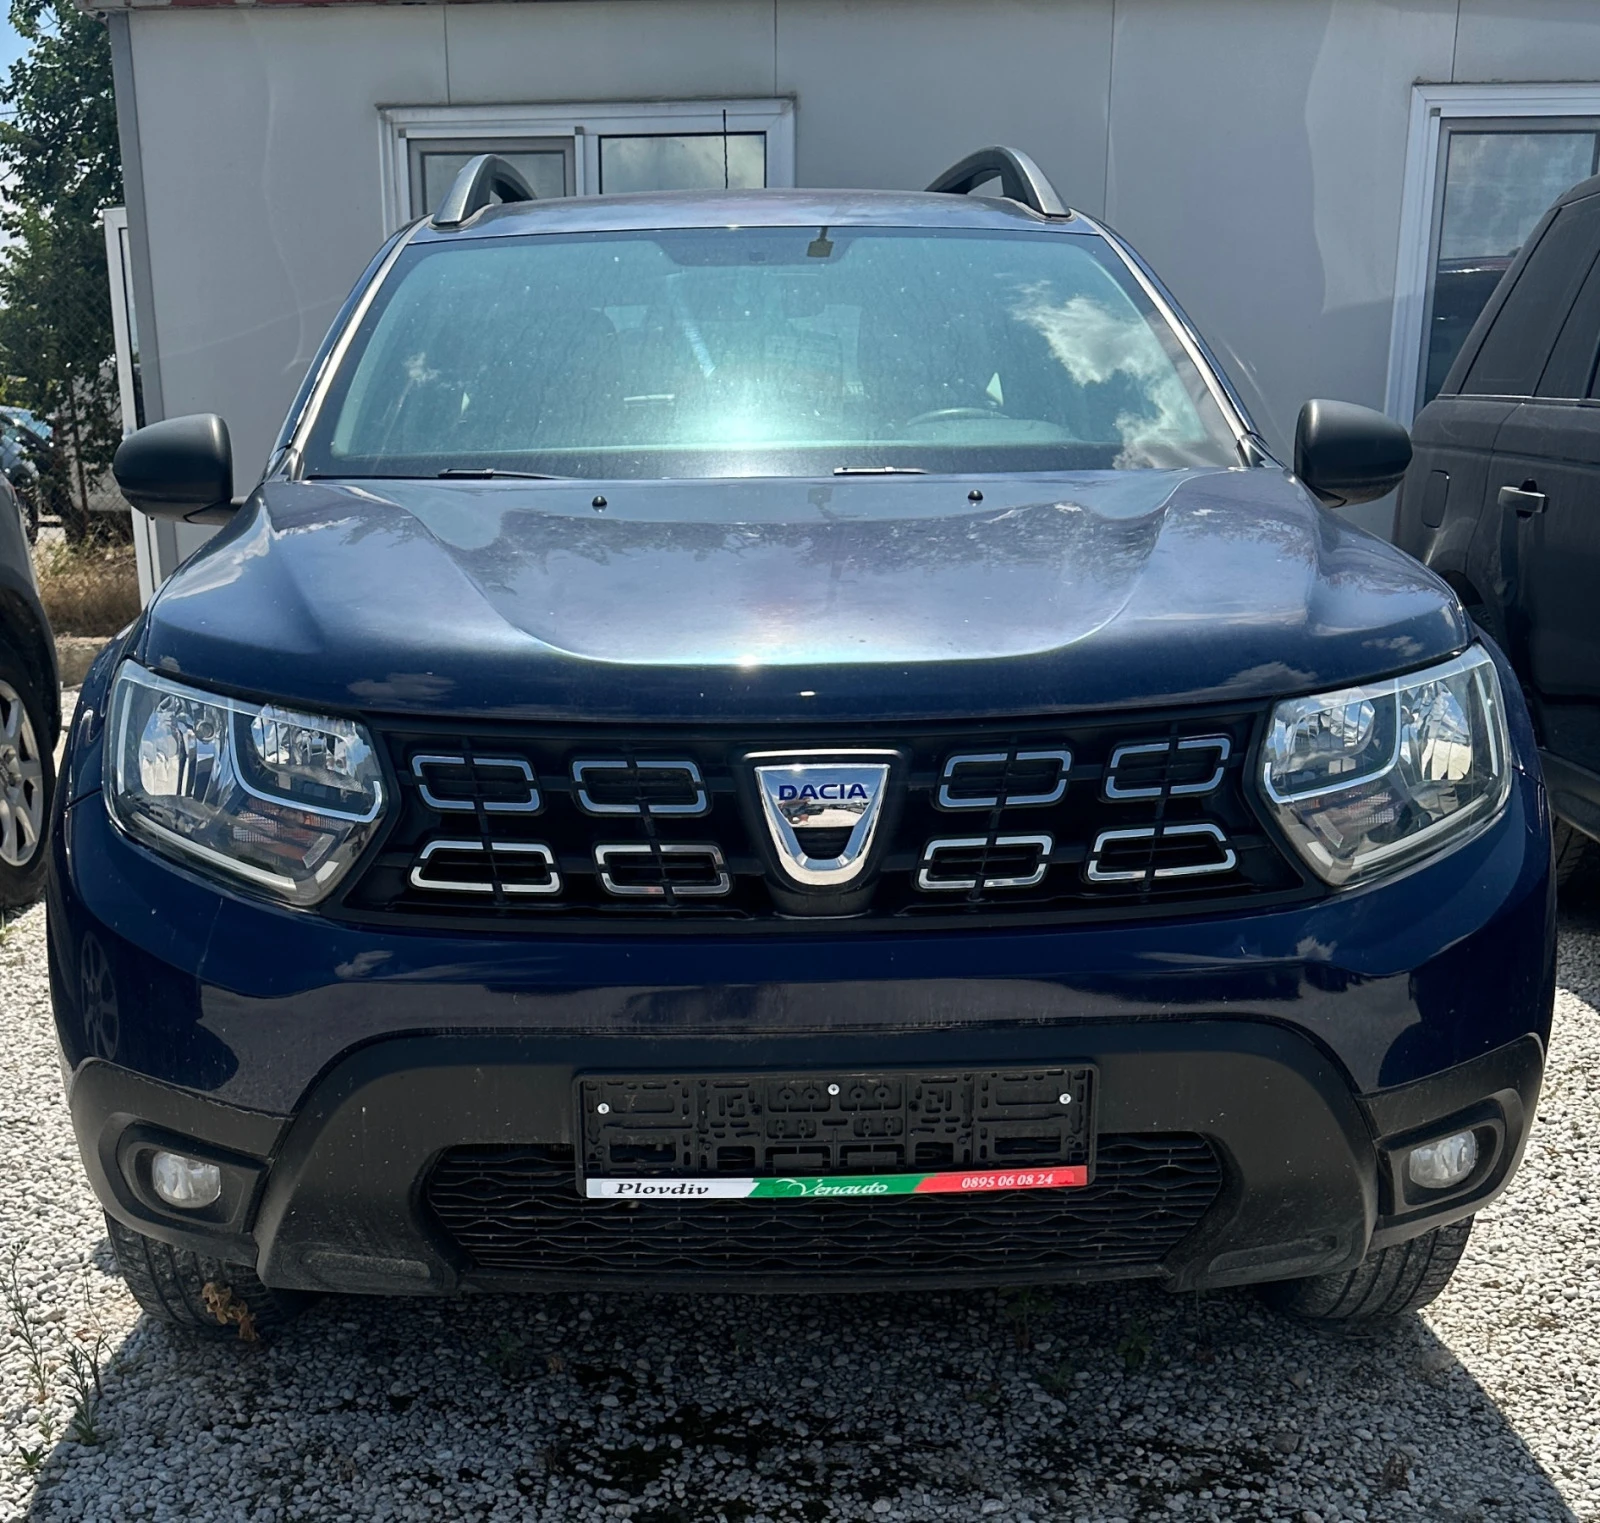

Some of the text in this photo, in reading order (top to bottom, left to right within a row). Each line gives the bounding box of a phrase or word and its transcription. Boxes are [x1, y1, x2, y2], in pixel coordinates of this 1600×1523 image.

[779, 783, 868, 800] DACIA
[615, 1173, 1054, 1196] Plovdiv Venauto 0895 06 08 24
